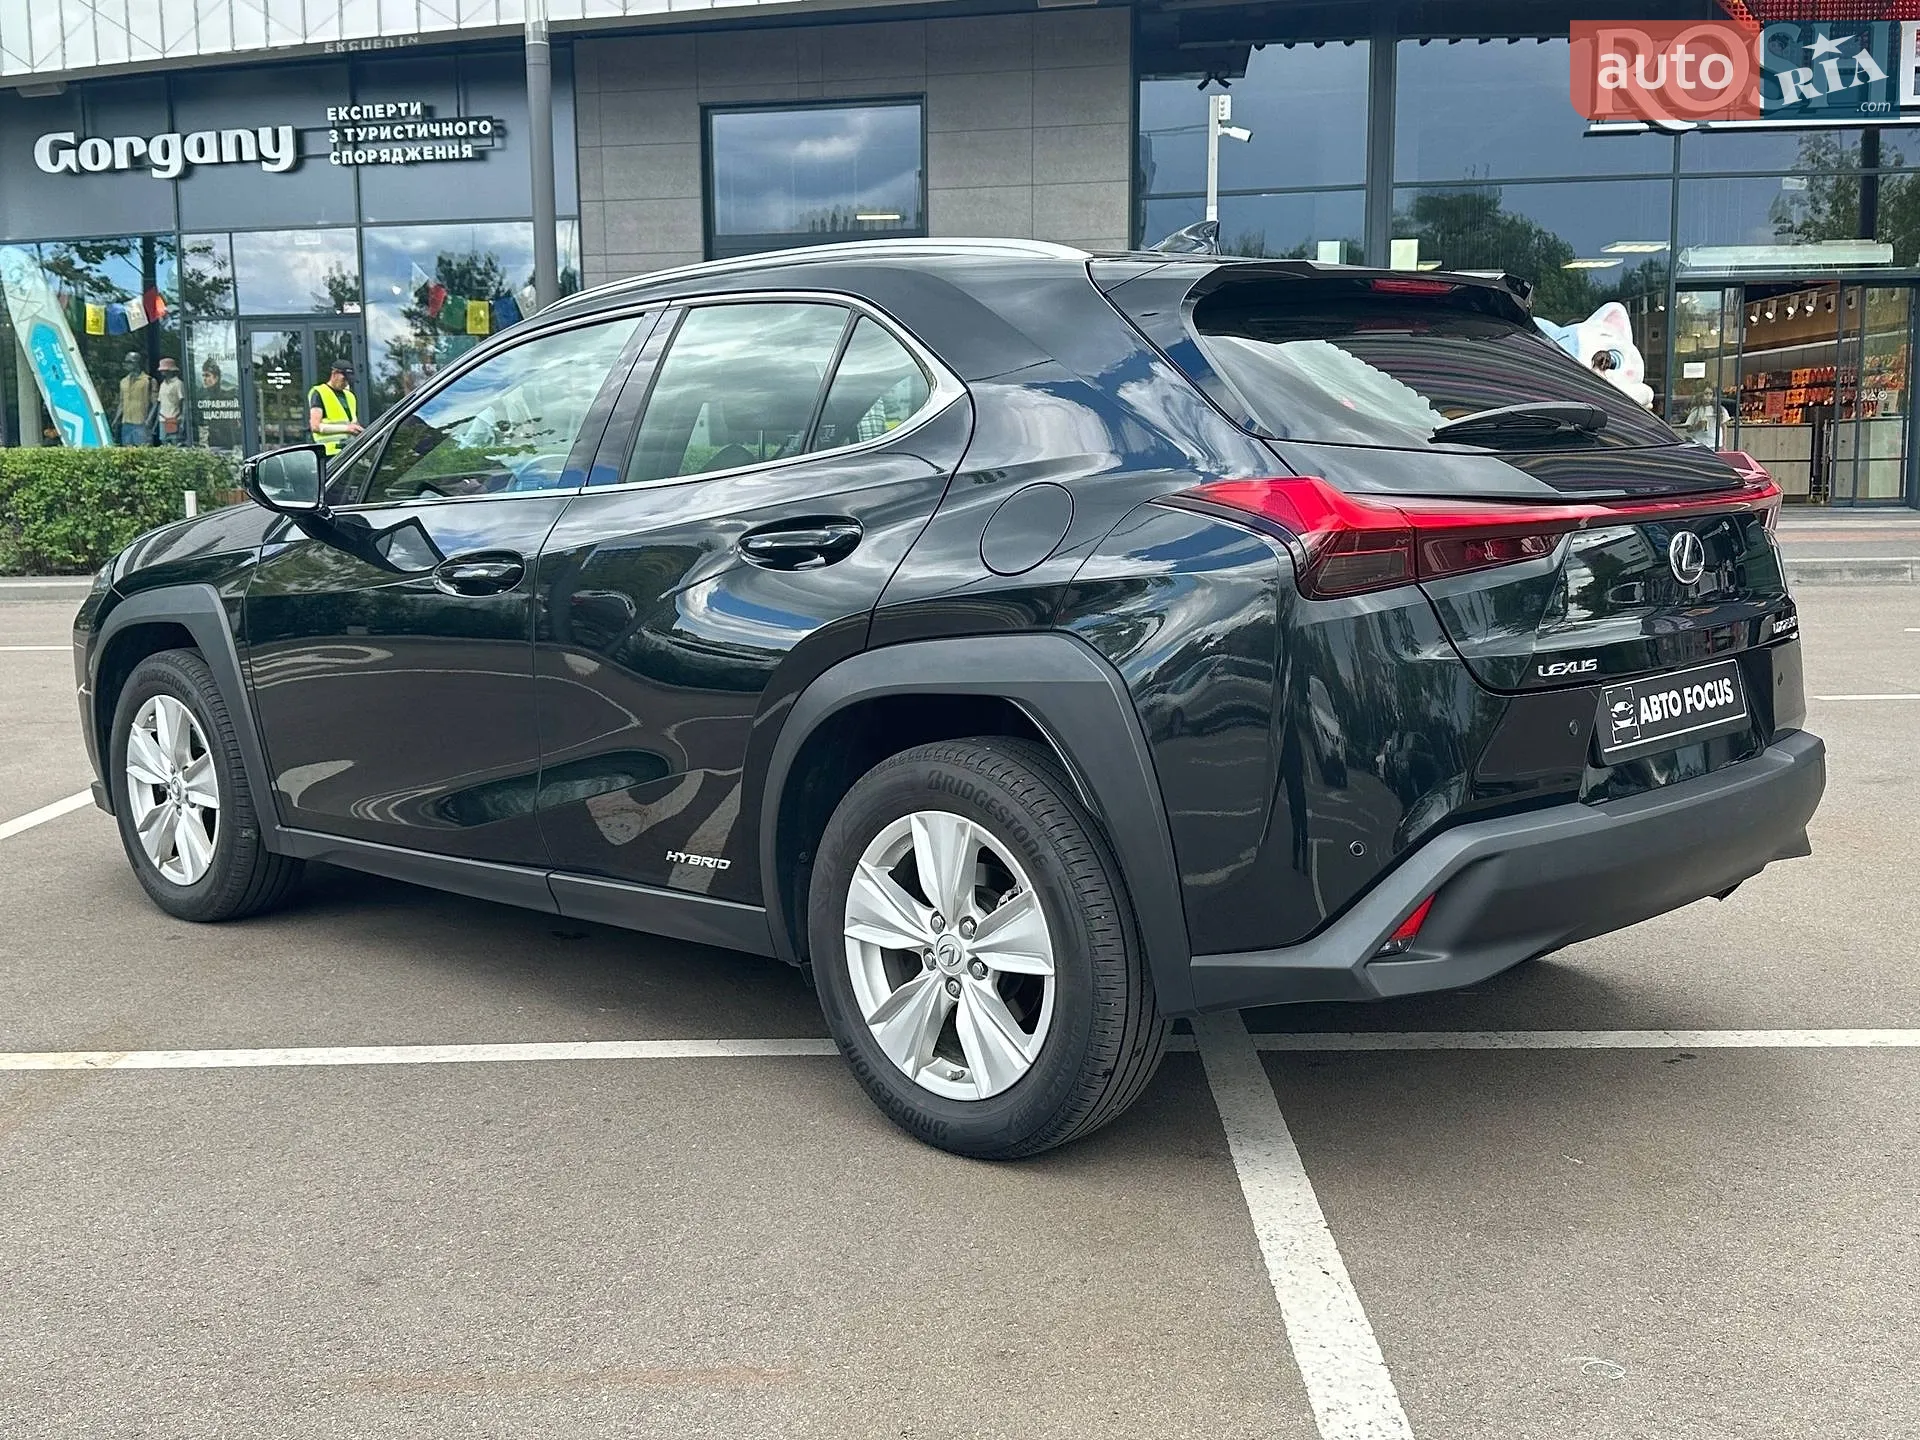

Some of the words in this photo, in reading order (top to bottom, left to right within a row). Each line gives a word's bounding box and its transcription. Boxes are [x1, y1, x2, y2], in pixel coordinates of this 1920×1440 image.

[327, 102, 422, 121] ЕКСПЕРТИ
[344, 120, 492, 142] ТУРИСТИЧНОГО
[34, 125, 296, 179] Gorgany
[329, 144, 473, 165] СПОРЯДЖЕННЯ
[1537, 658, 1598, 678] LEXUS
[1683, 678, 1734, 714] FOCUS
[926, 769, 1049, 870] BRIDGESTONE
[665, 850, 731, 870] HYBRID
